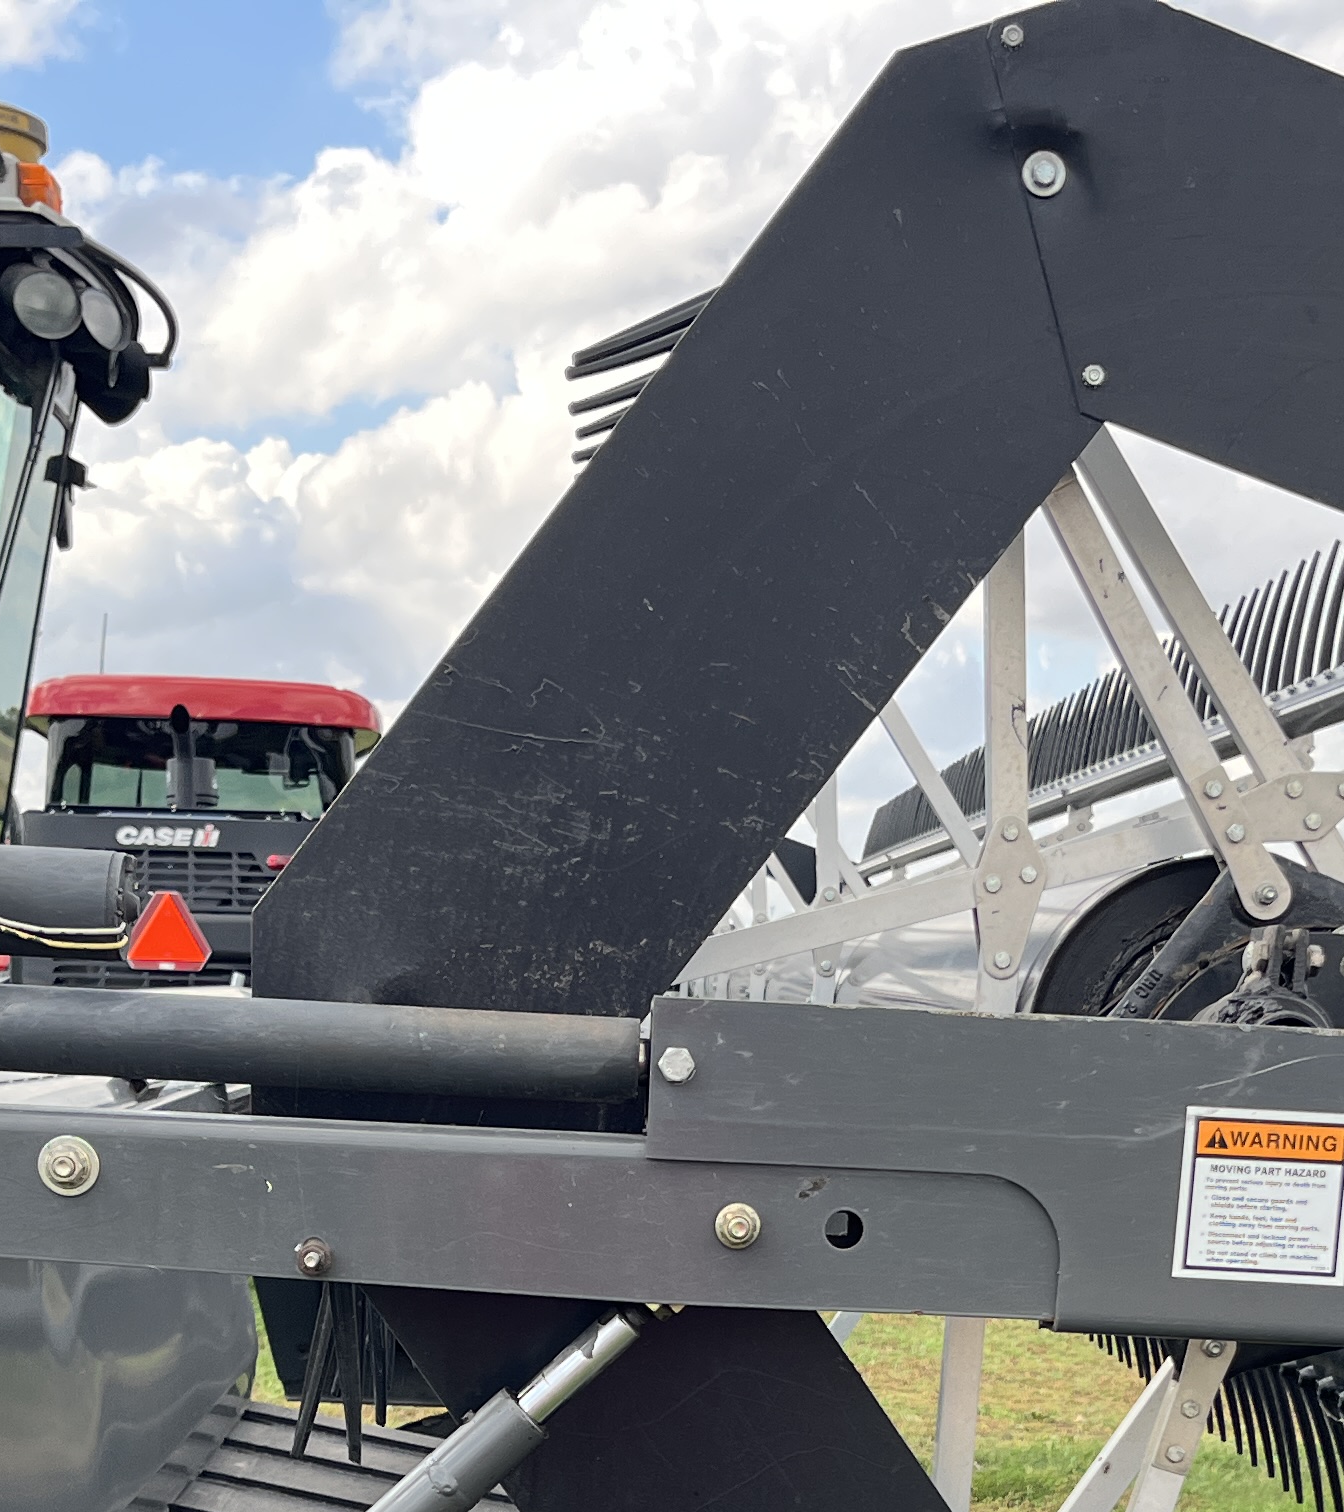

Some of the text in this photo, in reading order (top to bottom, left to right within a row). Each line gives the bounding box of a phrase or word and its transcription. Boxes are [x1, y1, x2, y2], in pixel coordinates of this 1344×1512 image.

[115, 825, 194, 847] CASE
[1230, 1130, 1337, 1152] WARNING
[1210, 1164, 1327, 1178] MOVING PART HAZARD
